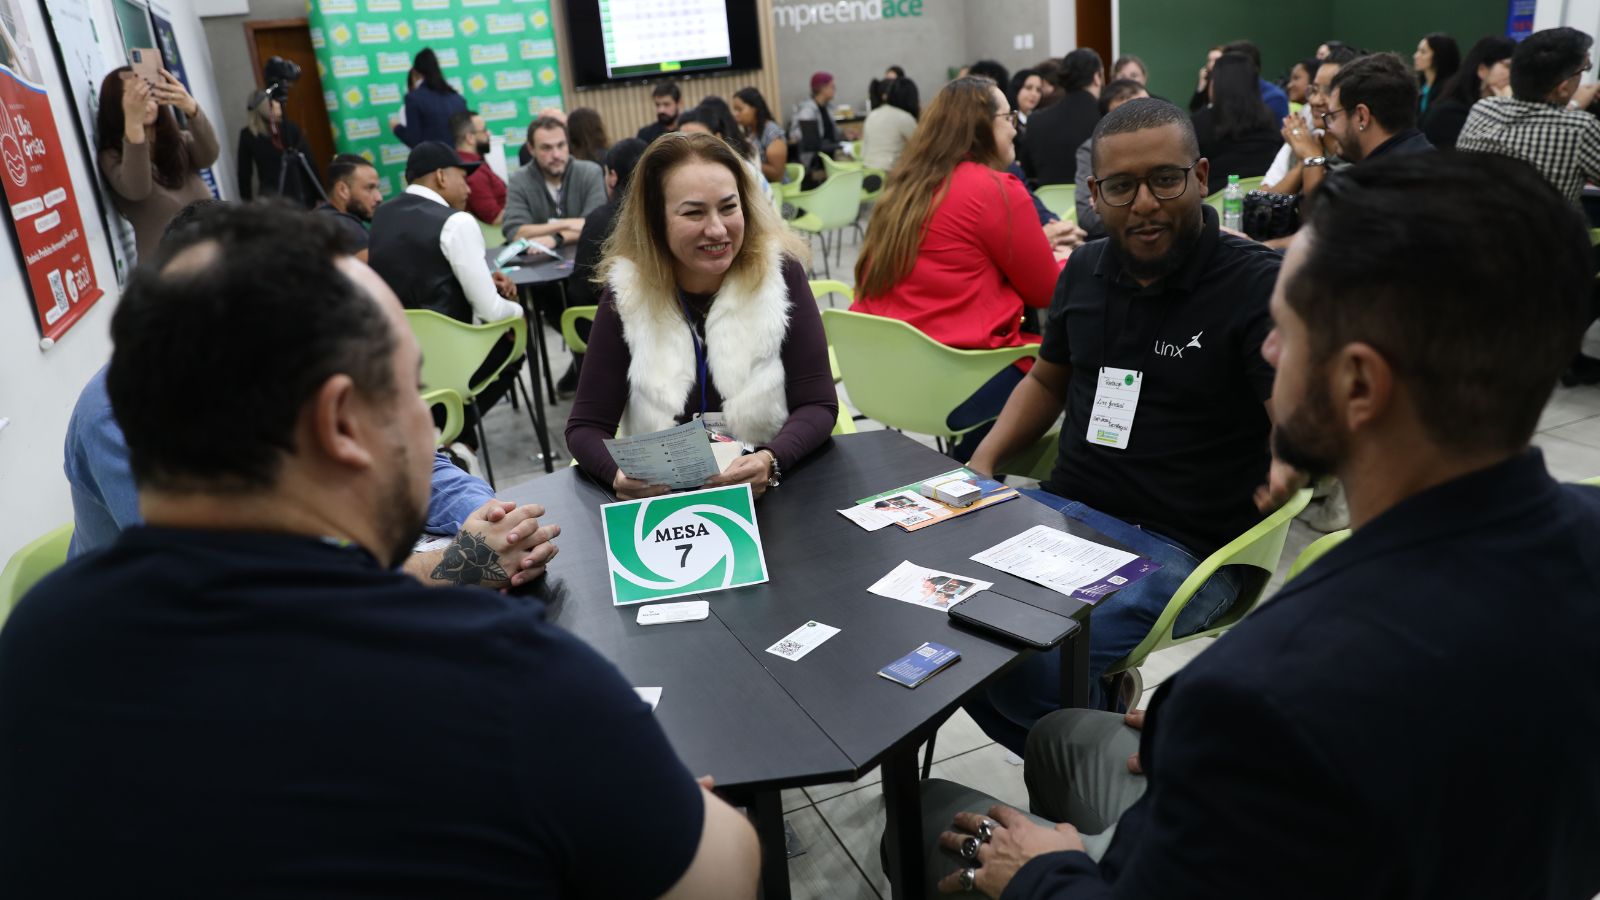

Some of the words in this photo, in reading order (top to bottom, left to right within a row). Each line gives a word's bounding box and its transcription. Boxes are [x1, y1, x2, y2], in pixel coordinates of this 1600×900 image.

[773, 0, 922, 32] mpreendace
[1154, 340, 1185, 358] Linx
[654, 522, 710, 543] MESA
[675, 543, 693, 568] 7
